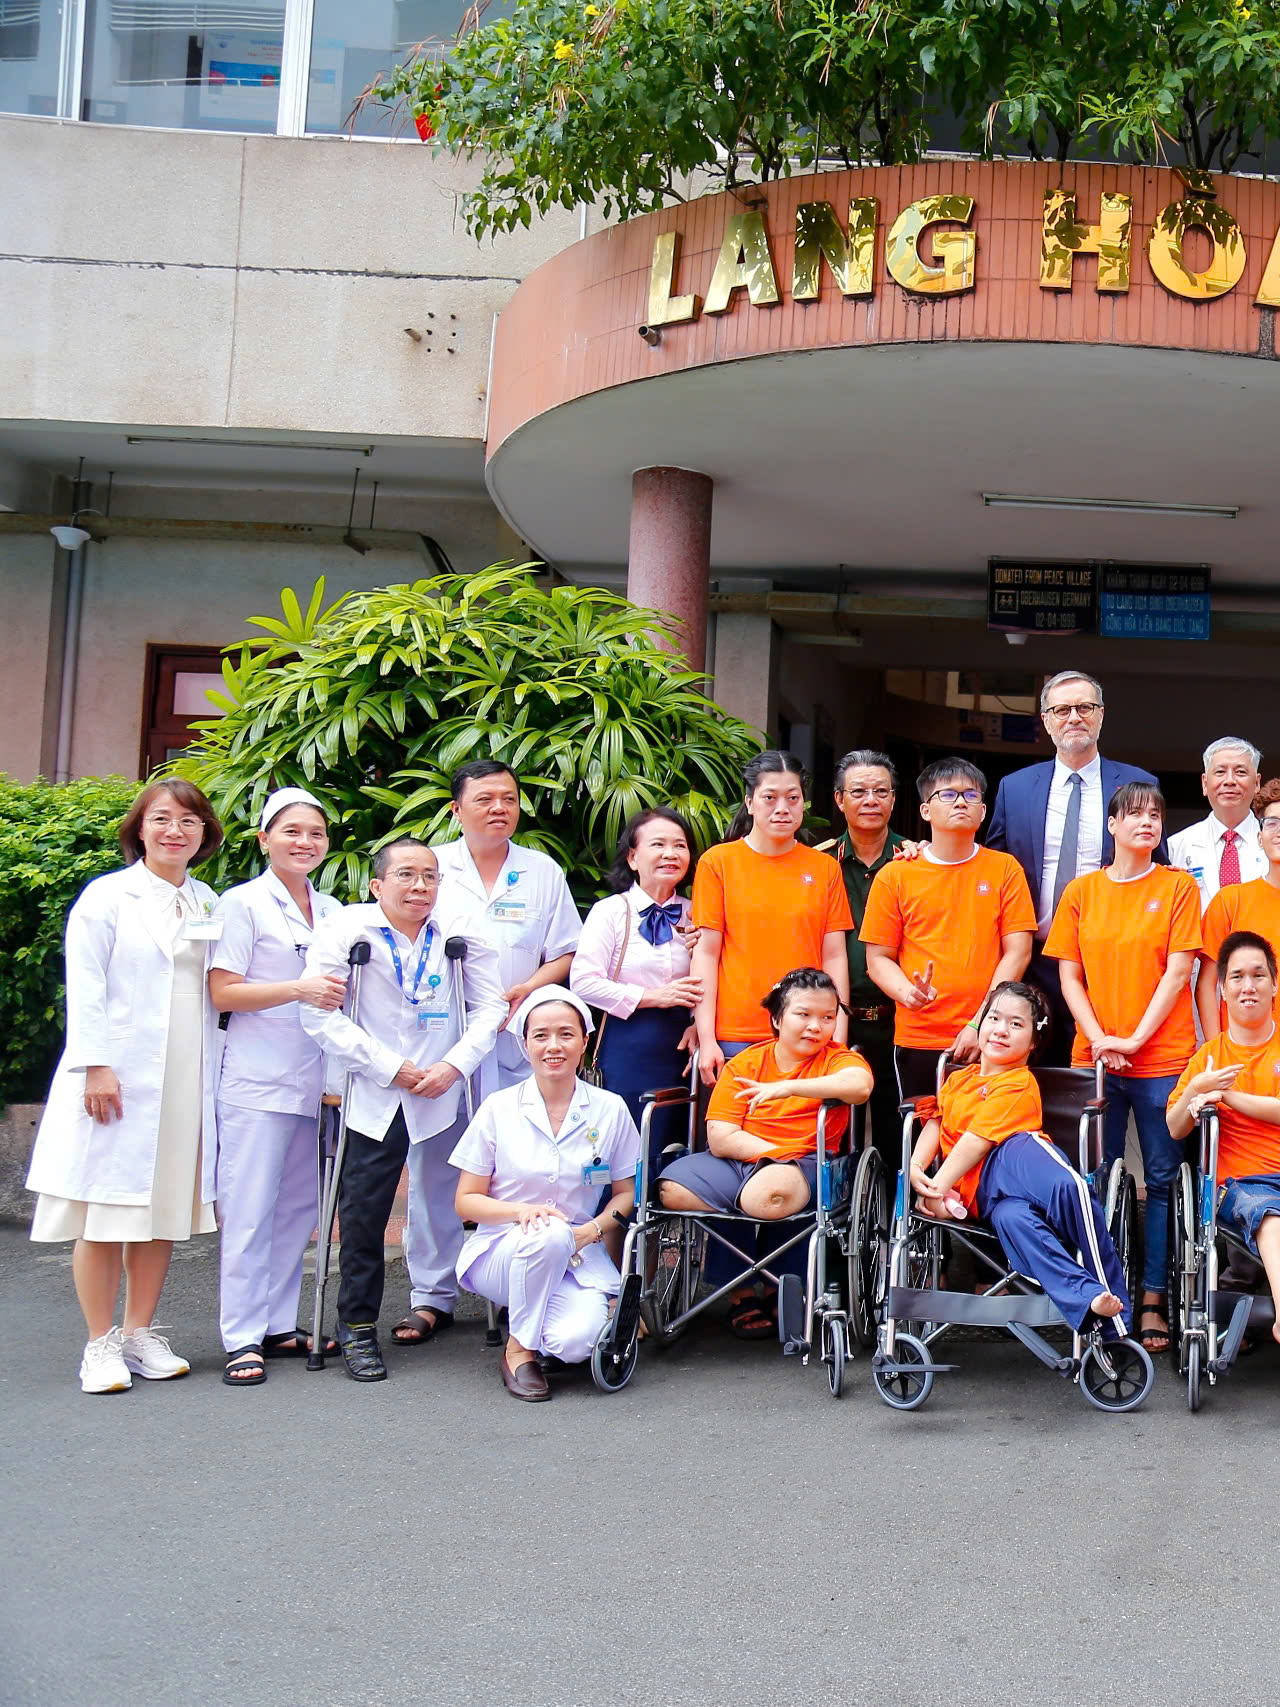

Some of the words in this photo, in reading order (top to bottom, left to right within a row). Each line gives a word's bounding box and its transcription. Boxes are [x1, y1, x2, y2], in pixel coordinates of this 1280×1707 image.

[995, 569, 1023, 584] DONATED
[1025, 569, 1042, 584] FROM
[1044, 570, 1064, 585] PEACE
[1066, 571, 1092, 586] VILLAGE
